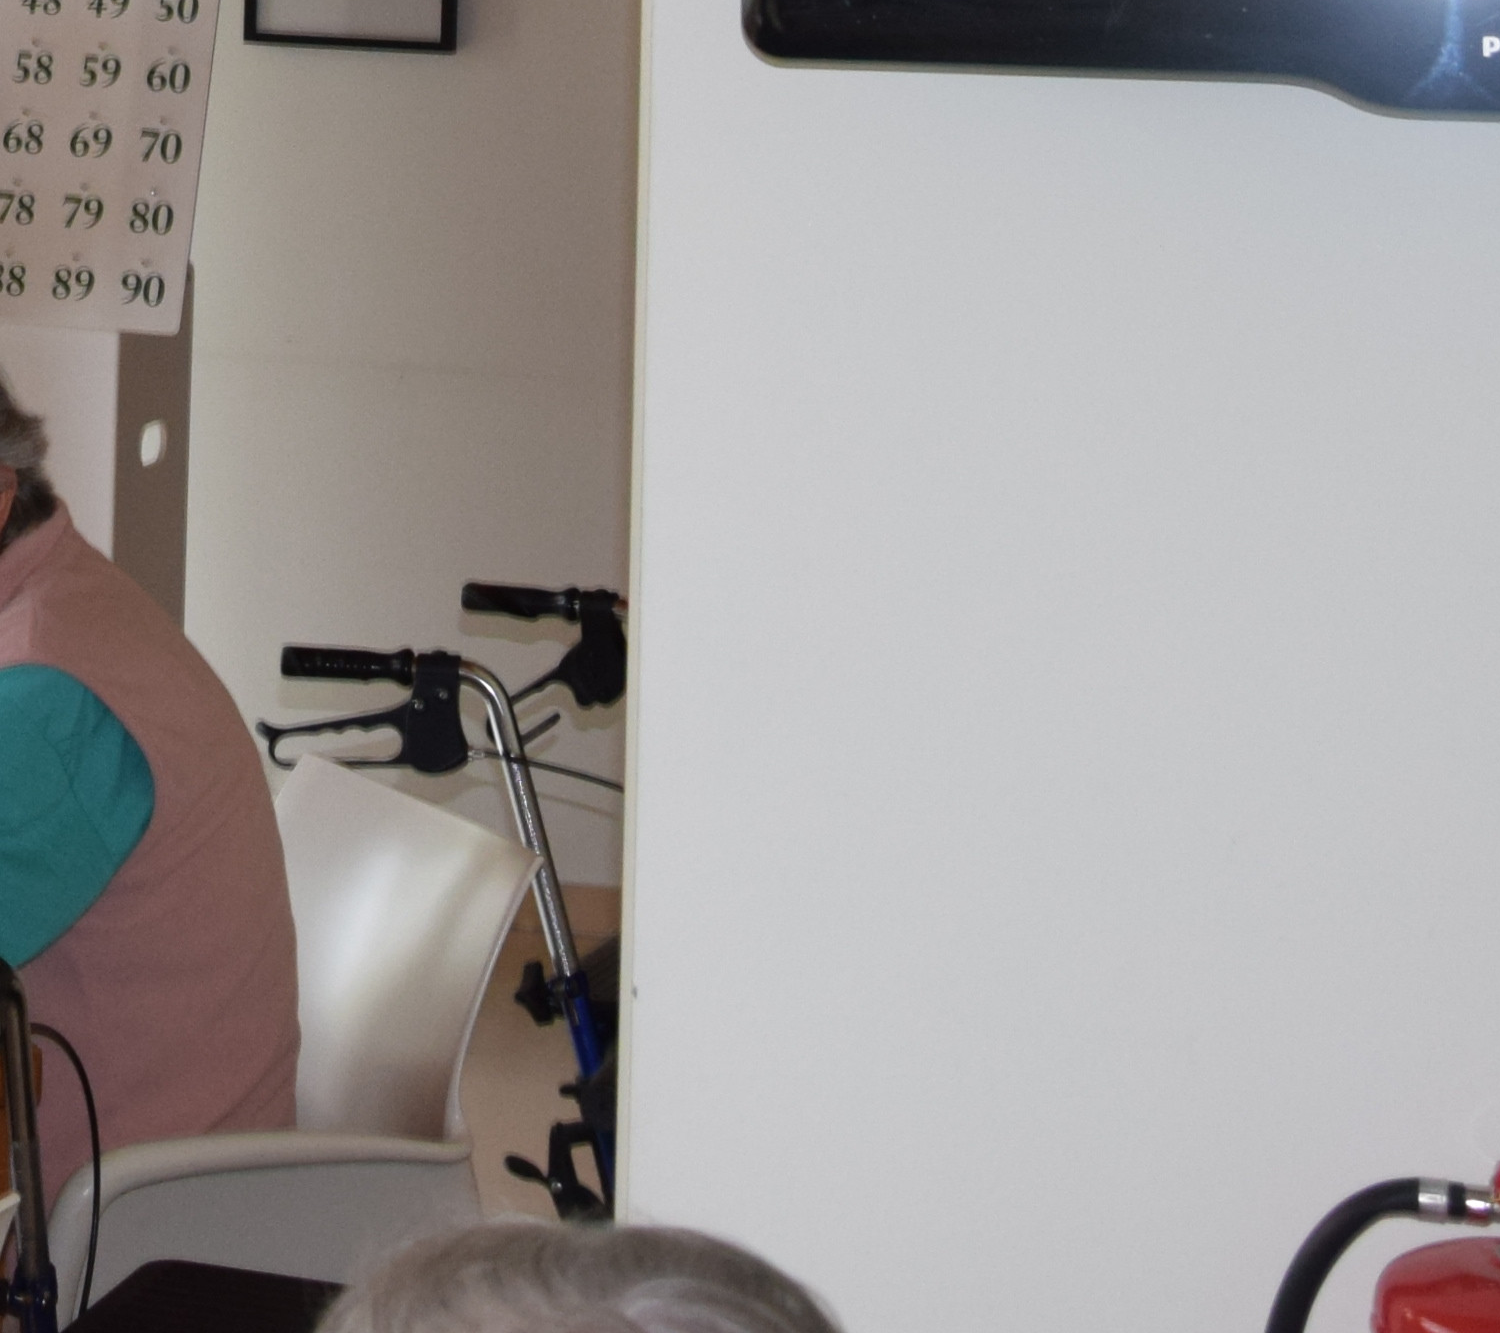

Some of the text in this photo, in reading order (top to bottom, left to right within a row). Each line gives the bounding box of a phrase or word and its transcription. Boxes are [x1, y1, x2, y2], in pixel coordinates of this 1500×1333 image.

[11, 49, 55, 86] 58
[77, 52, 123, 89] 59
[145, 61, 192, 95] 60
[1, 122, 46, 156] 68
[68, 126, 114, 159] 69
[139, 126, 184, 165] 70
[61, 193, 105, 231] 79
[127, 200, 175, 236] 80
[50, 265, 96, 302] 89
[119, 272, 167, 308] 90
